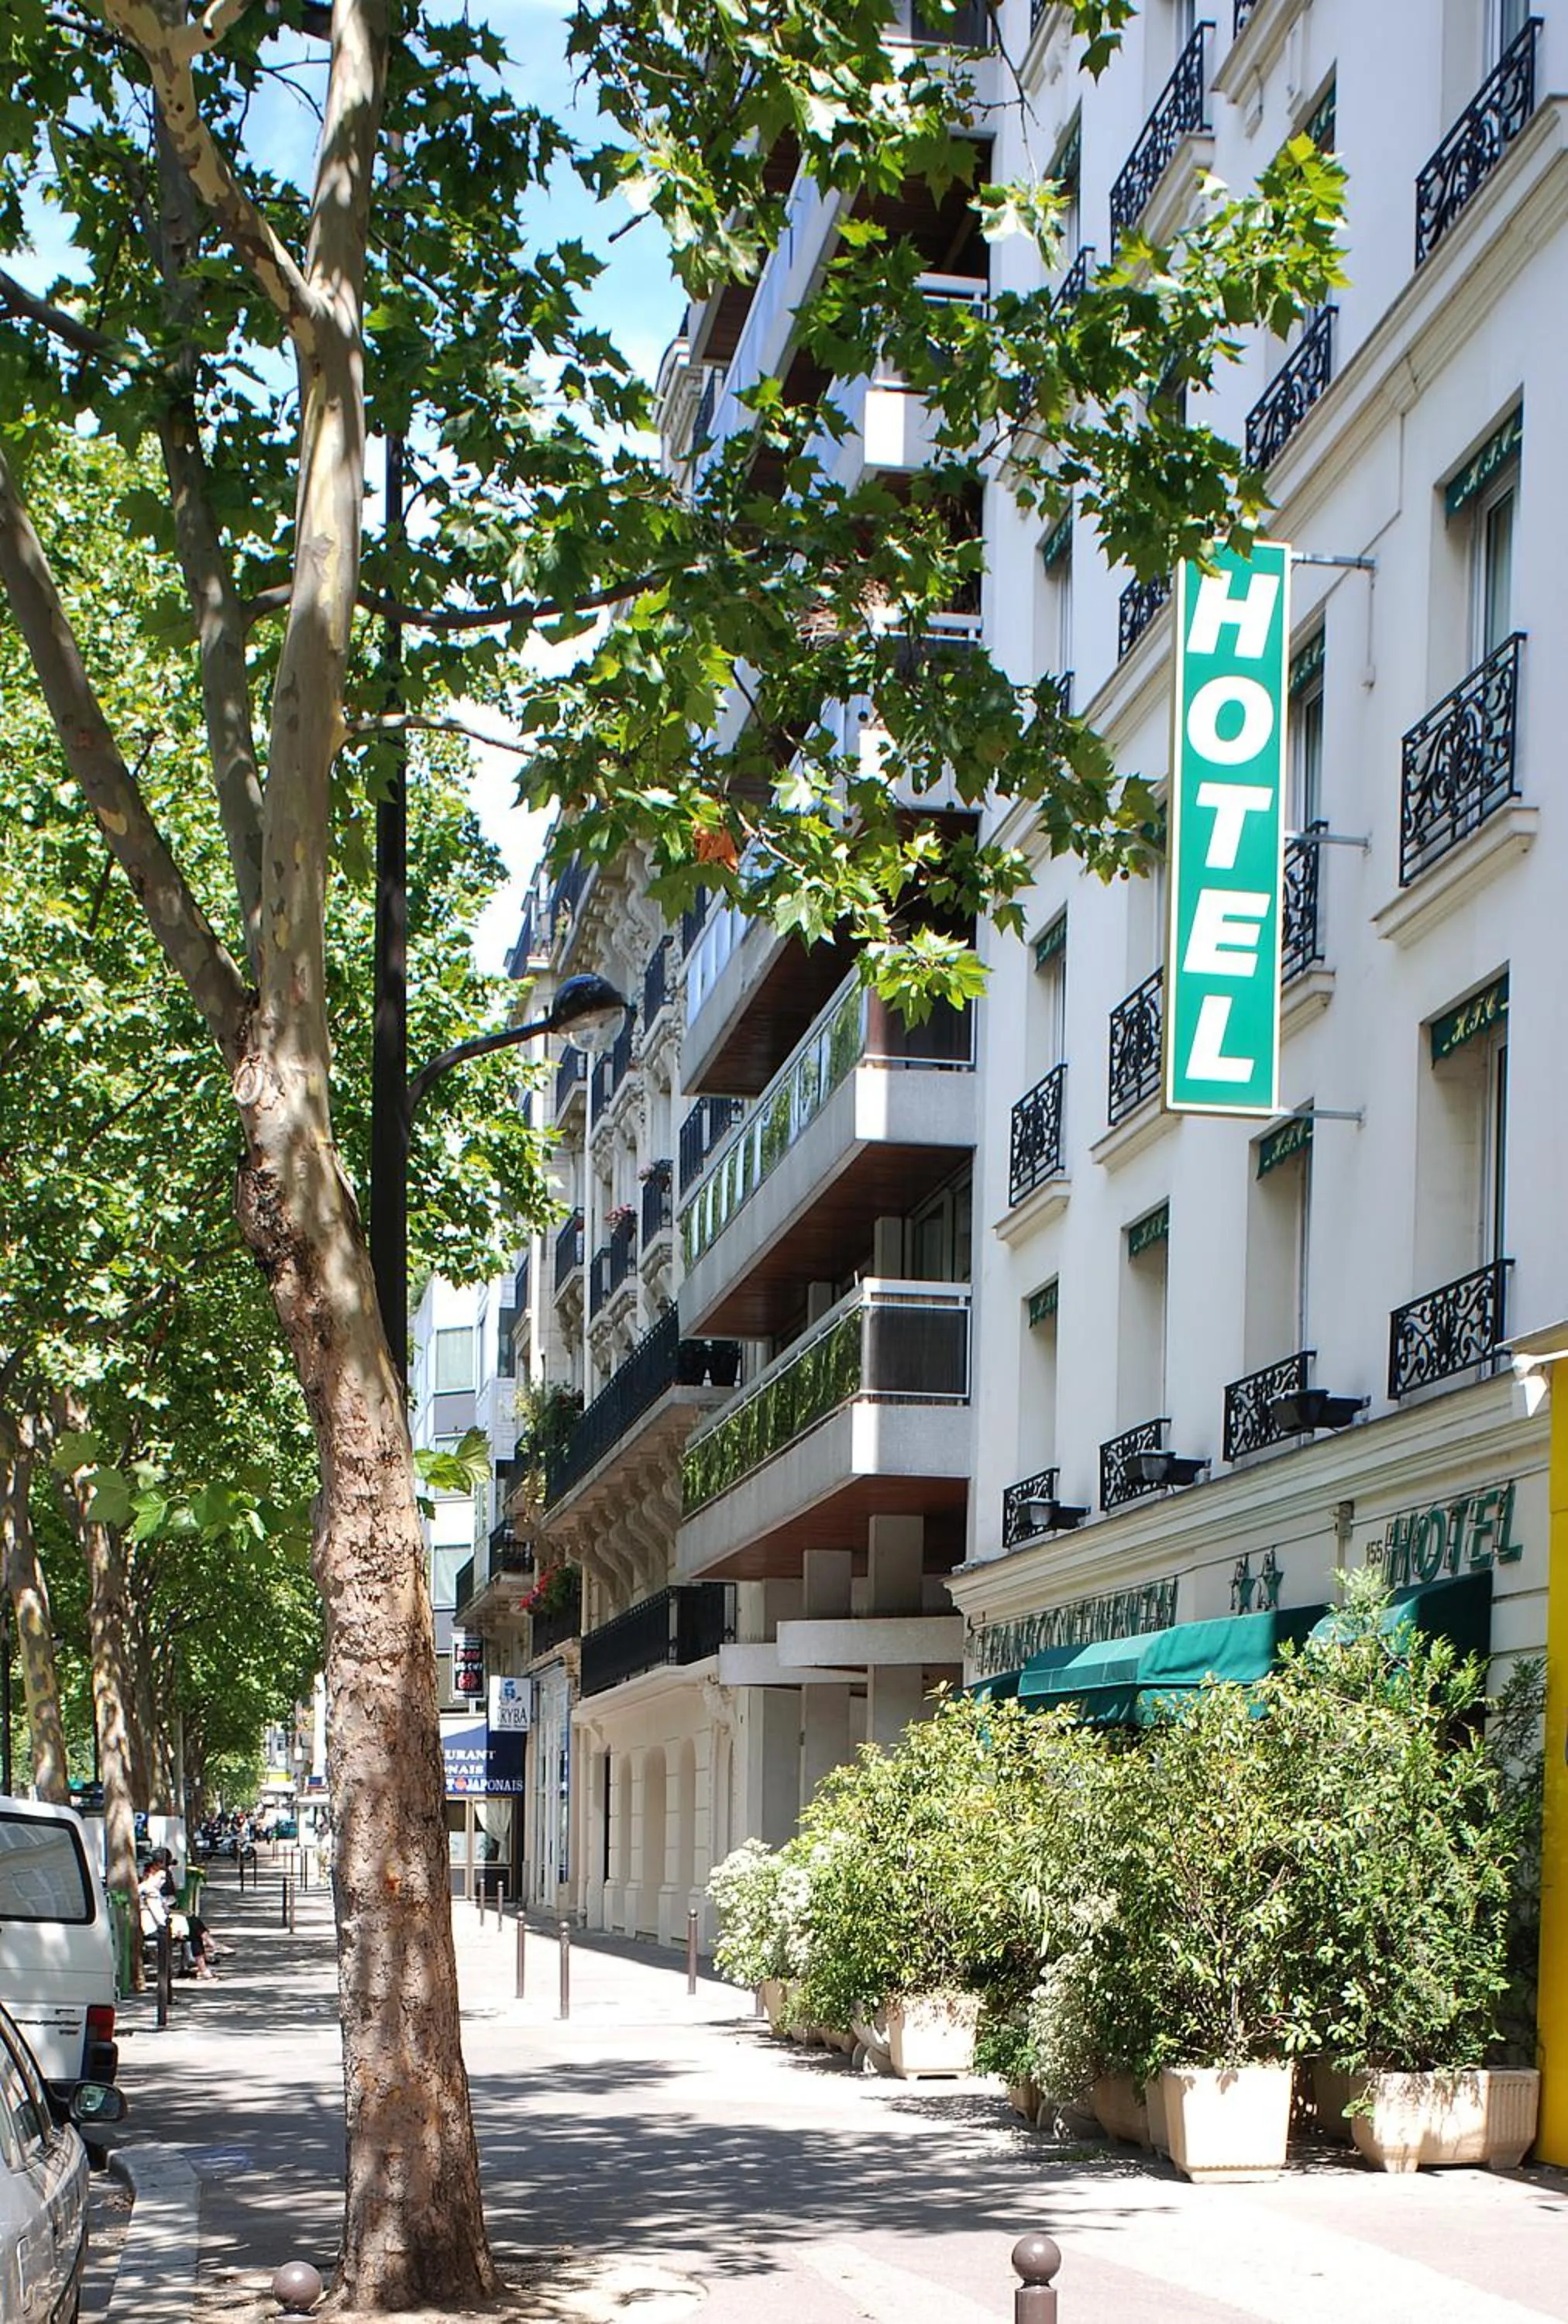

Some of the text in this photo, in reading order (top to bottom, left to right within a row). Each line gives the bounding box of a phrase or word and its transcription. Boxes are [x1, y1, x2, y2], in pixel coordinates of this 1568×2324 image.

[1182, 571, 1280, 1083] HOTEL
[1384, 1483, 1523, 1588] HOTEL
[1367, 1540, 1383, 1565] 155
[444, 1749, 496, 1760] URANT
[444, 1764, 484, 1775] NAIS
